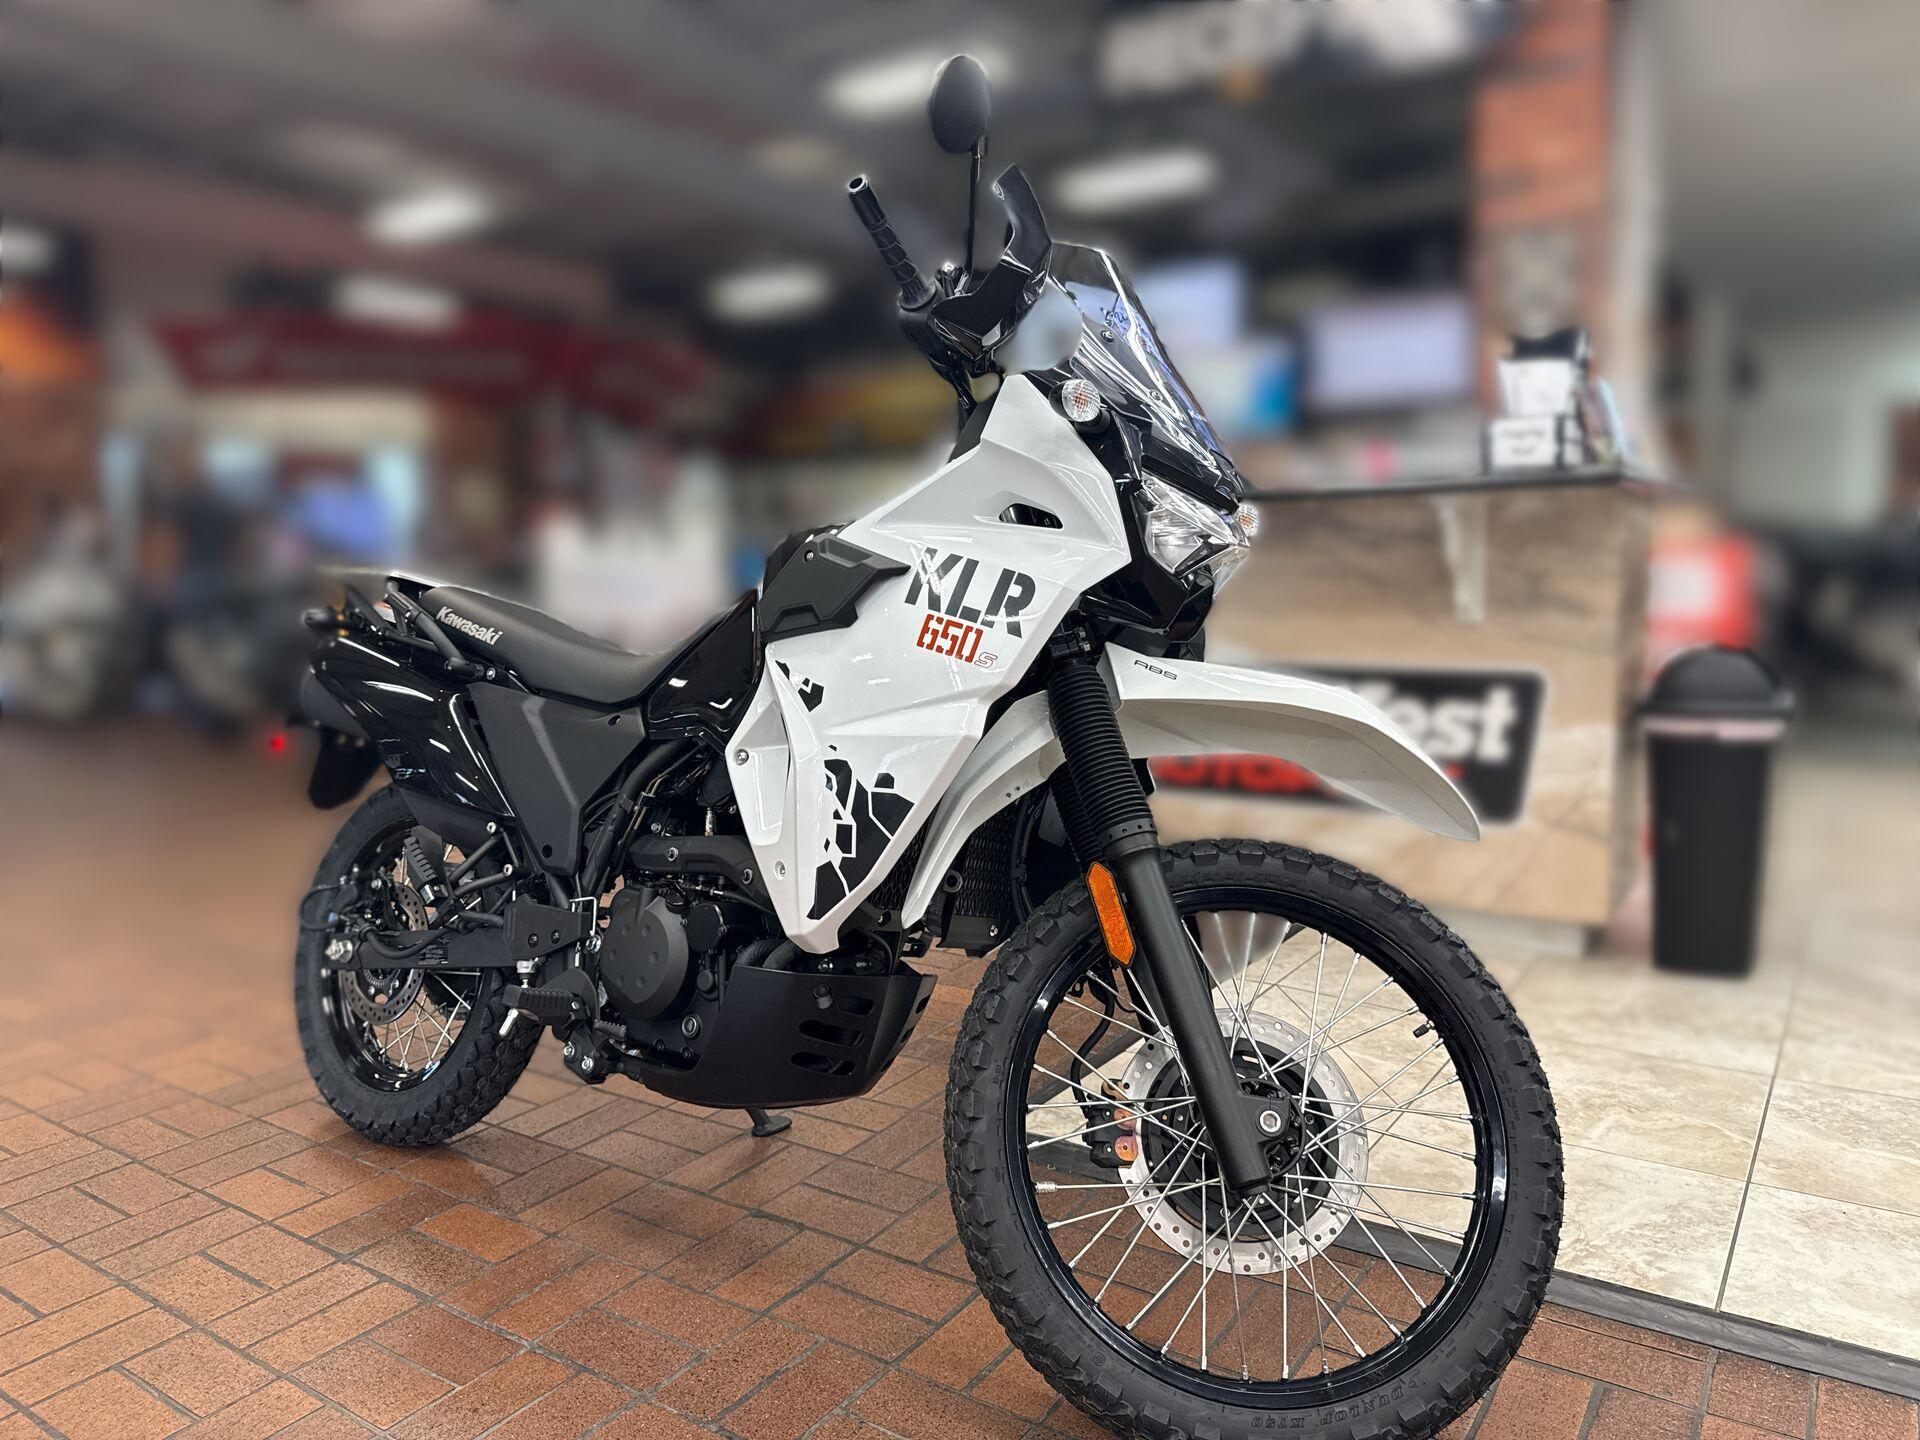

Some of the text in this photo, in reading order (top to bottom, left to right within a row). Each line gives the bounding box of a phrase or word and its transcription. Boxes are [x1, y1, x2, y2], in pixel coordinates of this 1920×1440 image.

[904, 547, 1036, 638] KLR
[436, 606, 503, 645] Kawasaki
[916, 613, 983, 664] 650
[1134, 659, 1178, 681] ABS
[1319, 1385, 1404, 1427] DUNLOP
